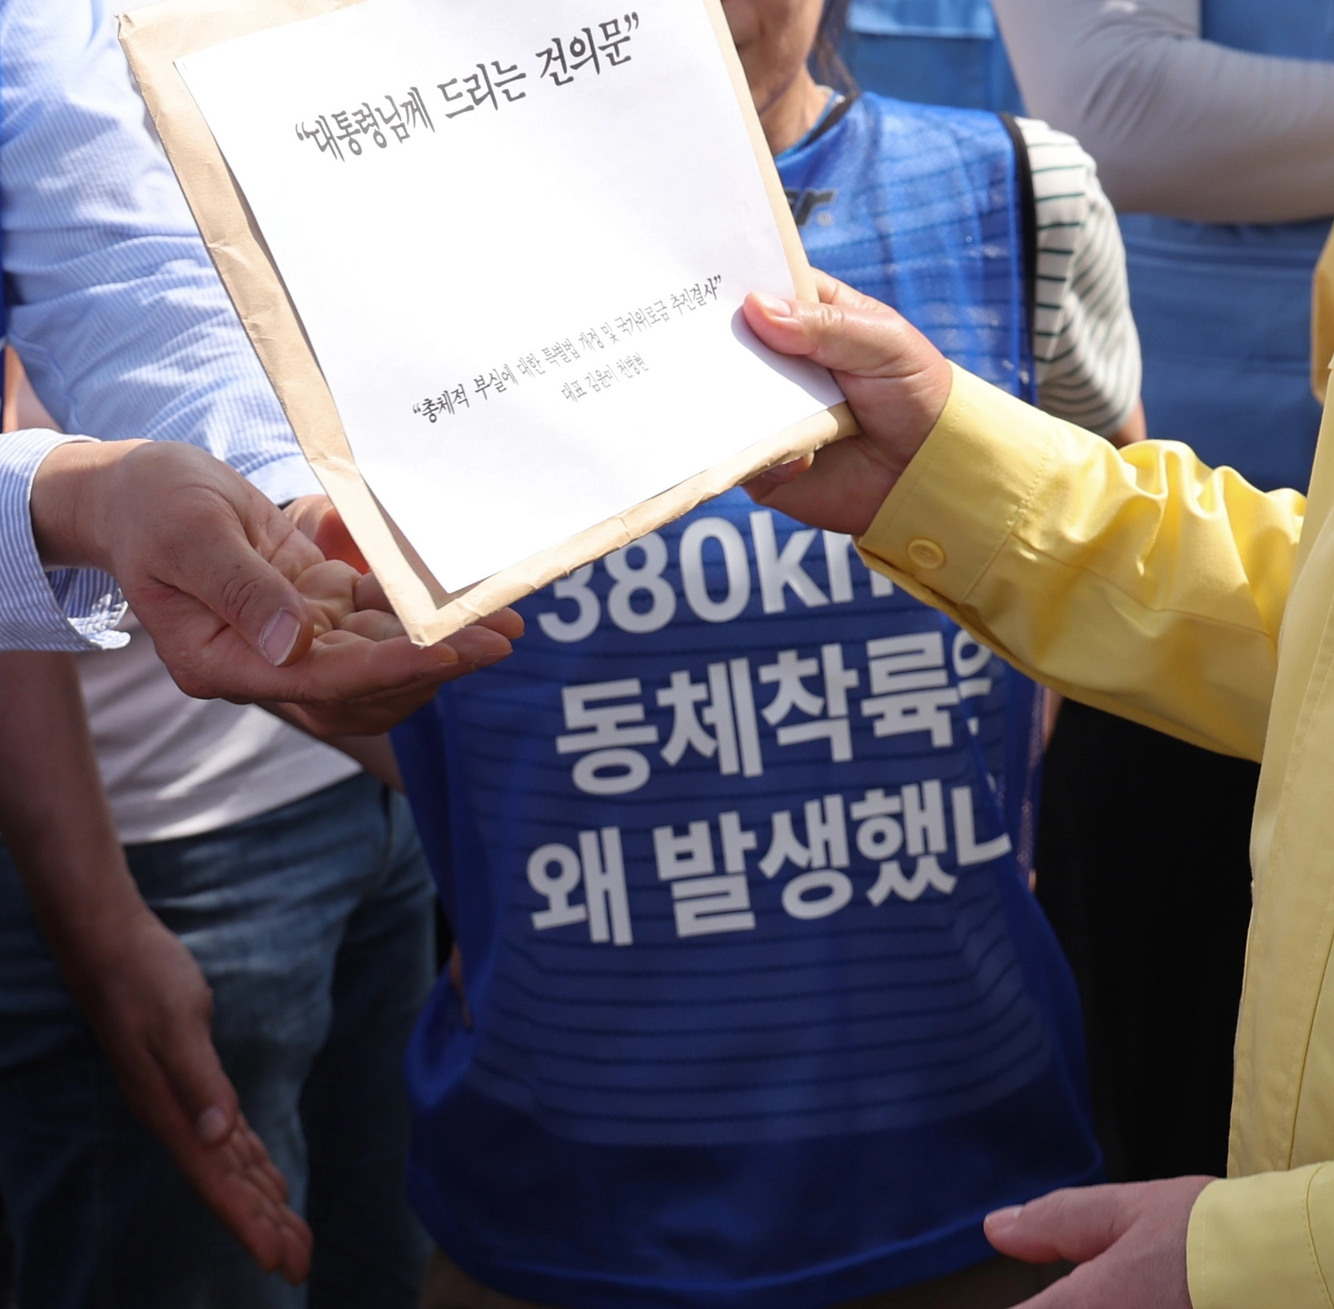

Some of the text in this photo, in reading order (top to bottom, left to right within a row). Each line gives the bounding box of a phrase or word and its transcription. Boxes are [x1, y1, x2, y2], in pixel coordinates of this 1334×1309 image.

[295, 11, 640, 162] “대통령님께 드리는 건의문”
[473, 363, 519, 401] 부실에
[517, 352, 546, 378] 대한
[541, 338, 580, 367] 특별법
[577, 328, 605, 352] 개정
[600, 321, 620, 345] 및
[614, 300, 670, 337] 국가위로금
[561, 382, 588, 403] 대표
[526, 826, 633, 946] 왜
